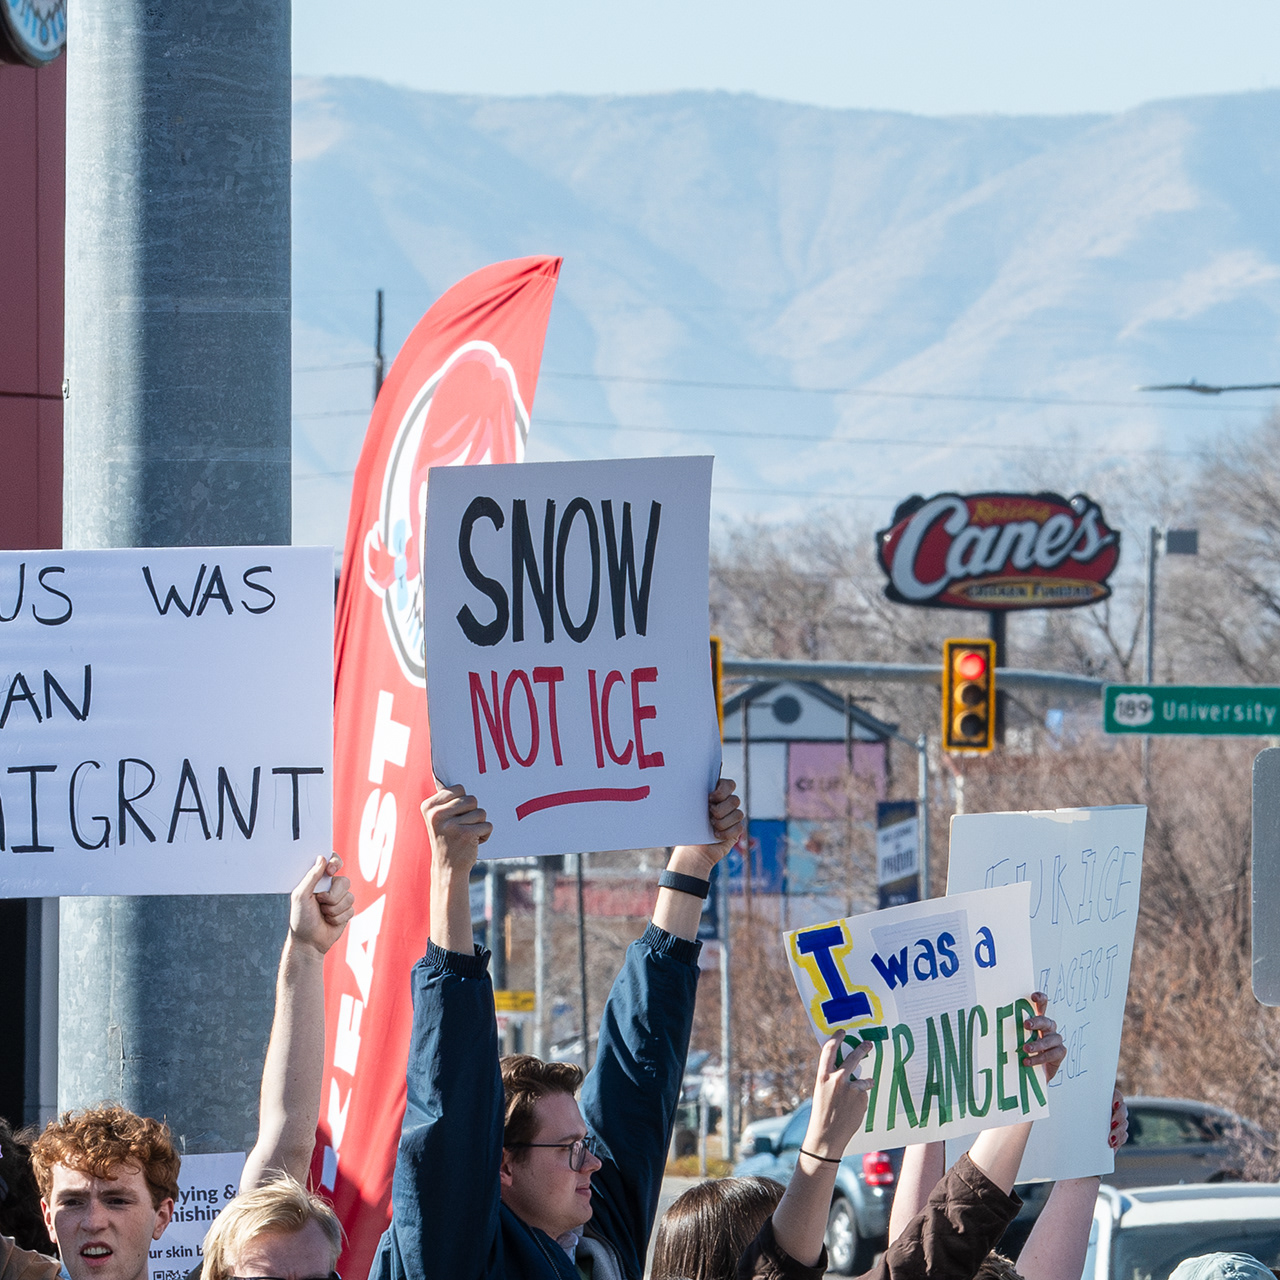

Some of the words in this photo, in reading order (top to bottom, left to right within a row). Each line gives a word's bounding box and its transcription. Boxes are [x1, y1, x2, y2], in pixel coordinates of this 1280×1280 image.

[456, 497, 662, 647] SNOW
[891, 496, 1115, 600] Cane's
[142, 563, 276, 618] WAS
[0, 665, 92, 729] AN
[468, 667, 564, 775] NOT
[589, 667, 665, 772] ICE
[1162, 699, 1277, 727] University
[796, 926, 873, 1025] I
[870, 931, 960, 991] was
[974, 926, 997, 969] a
[175, 1186, 219, 1205] ying
[223, 1184, 237, 1200] &
[166, 1245, 192, 1258] skin
